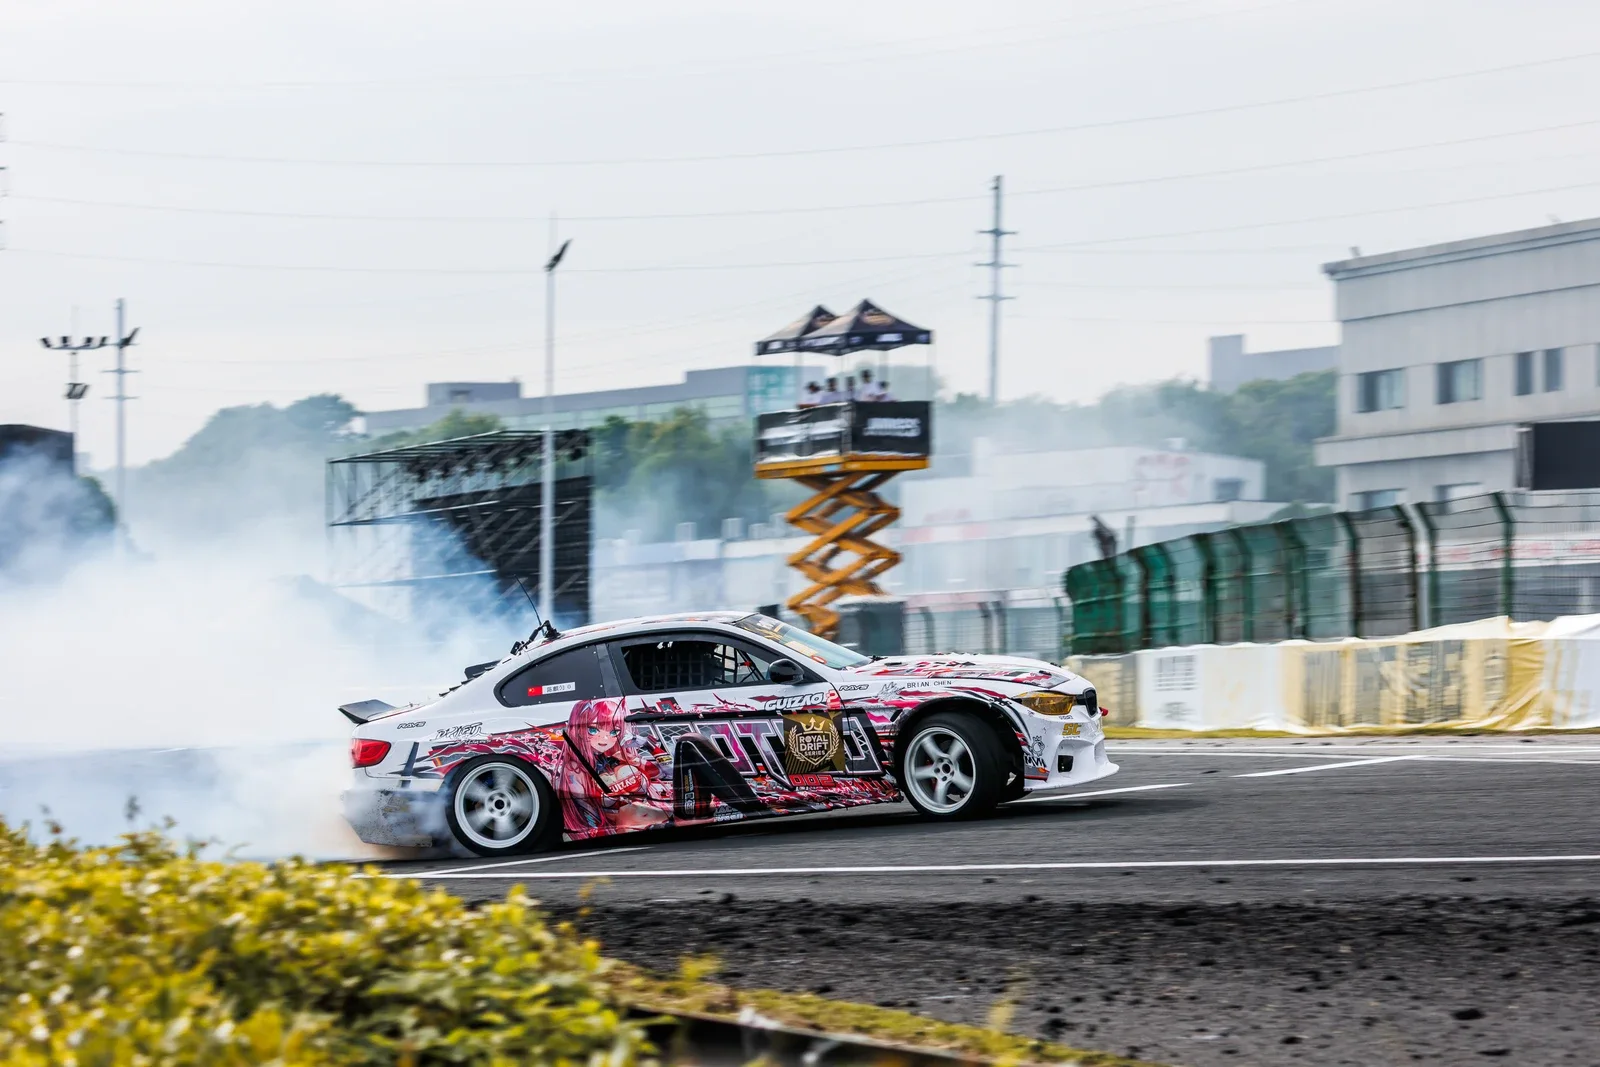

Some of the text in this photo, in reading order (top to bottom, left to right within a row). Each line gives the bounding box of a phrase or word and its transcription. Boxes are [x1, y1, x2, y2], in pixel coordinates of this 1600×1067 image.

[839, 683, 869, 692] RAYS
[764, 692, 824, 711] GUIZAO
[397, 721, 426, 729] RAYS
[799, 734, 829, 743] ROYAL
[799, 741, 829, 752] DRIFT
[788, 774, 837, 788] 002
